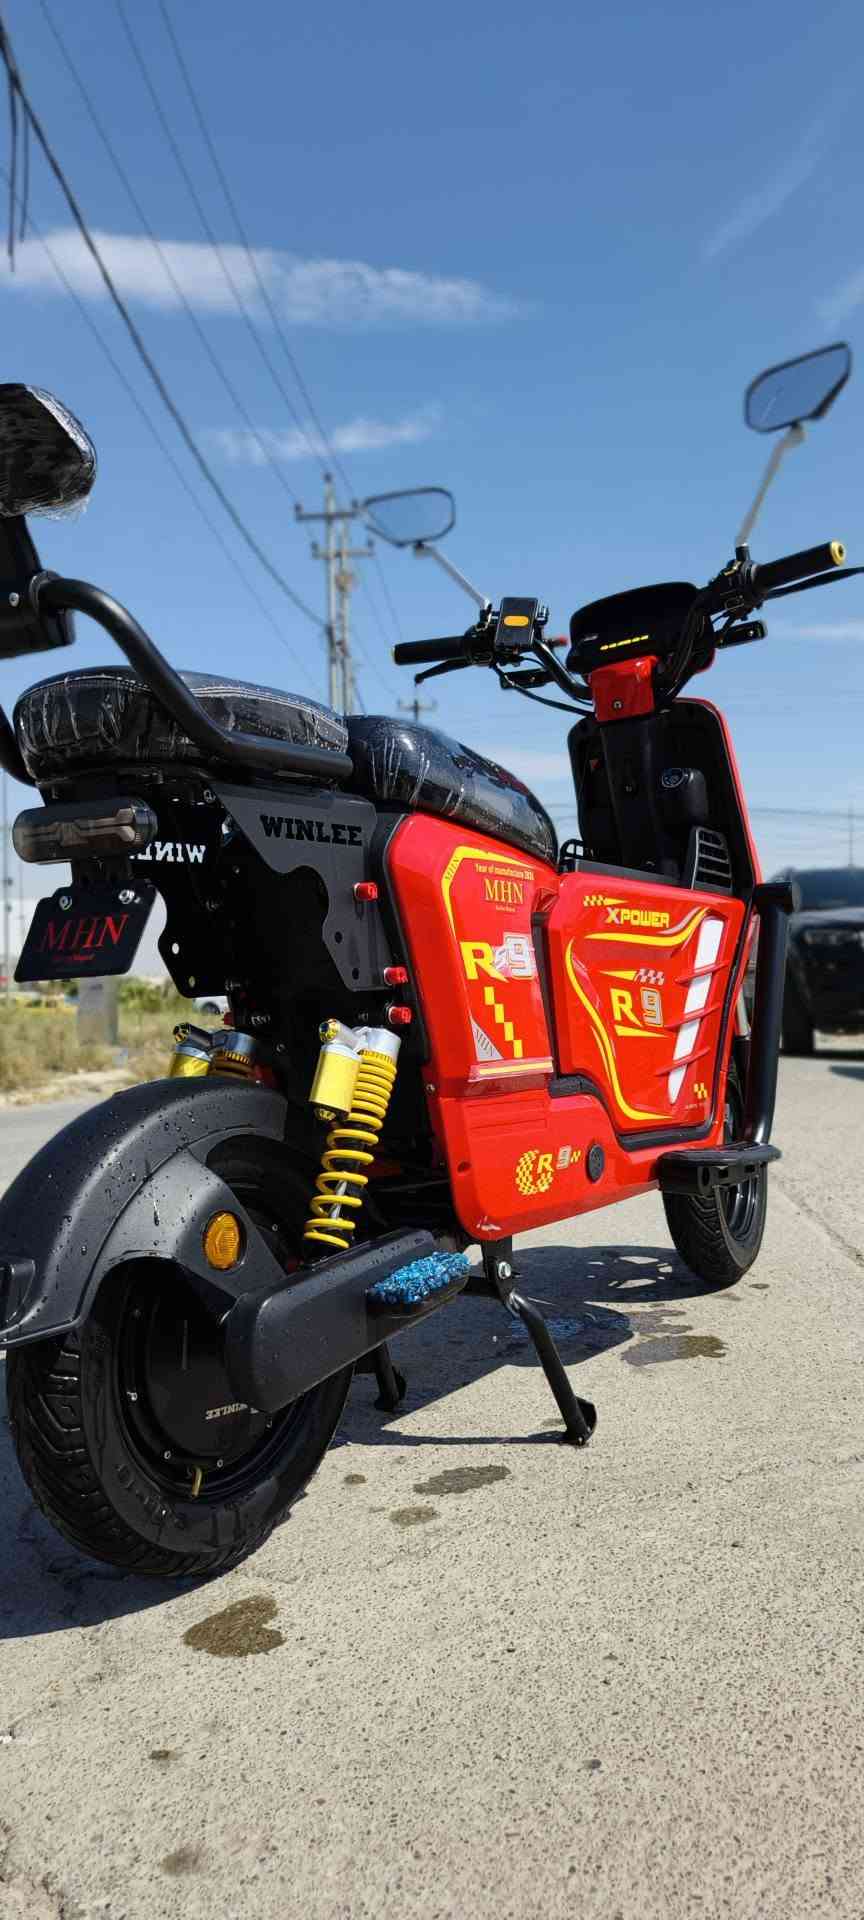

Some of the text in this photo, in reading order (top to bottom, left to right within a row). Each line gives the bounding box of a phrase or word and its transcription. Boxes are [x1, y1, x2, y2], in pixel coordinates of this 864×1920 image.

[260, 814, 362, 846] WINLEE
[484, 878, 523, 905] MHN
[36, 913, 129, 951] MHN
